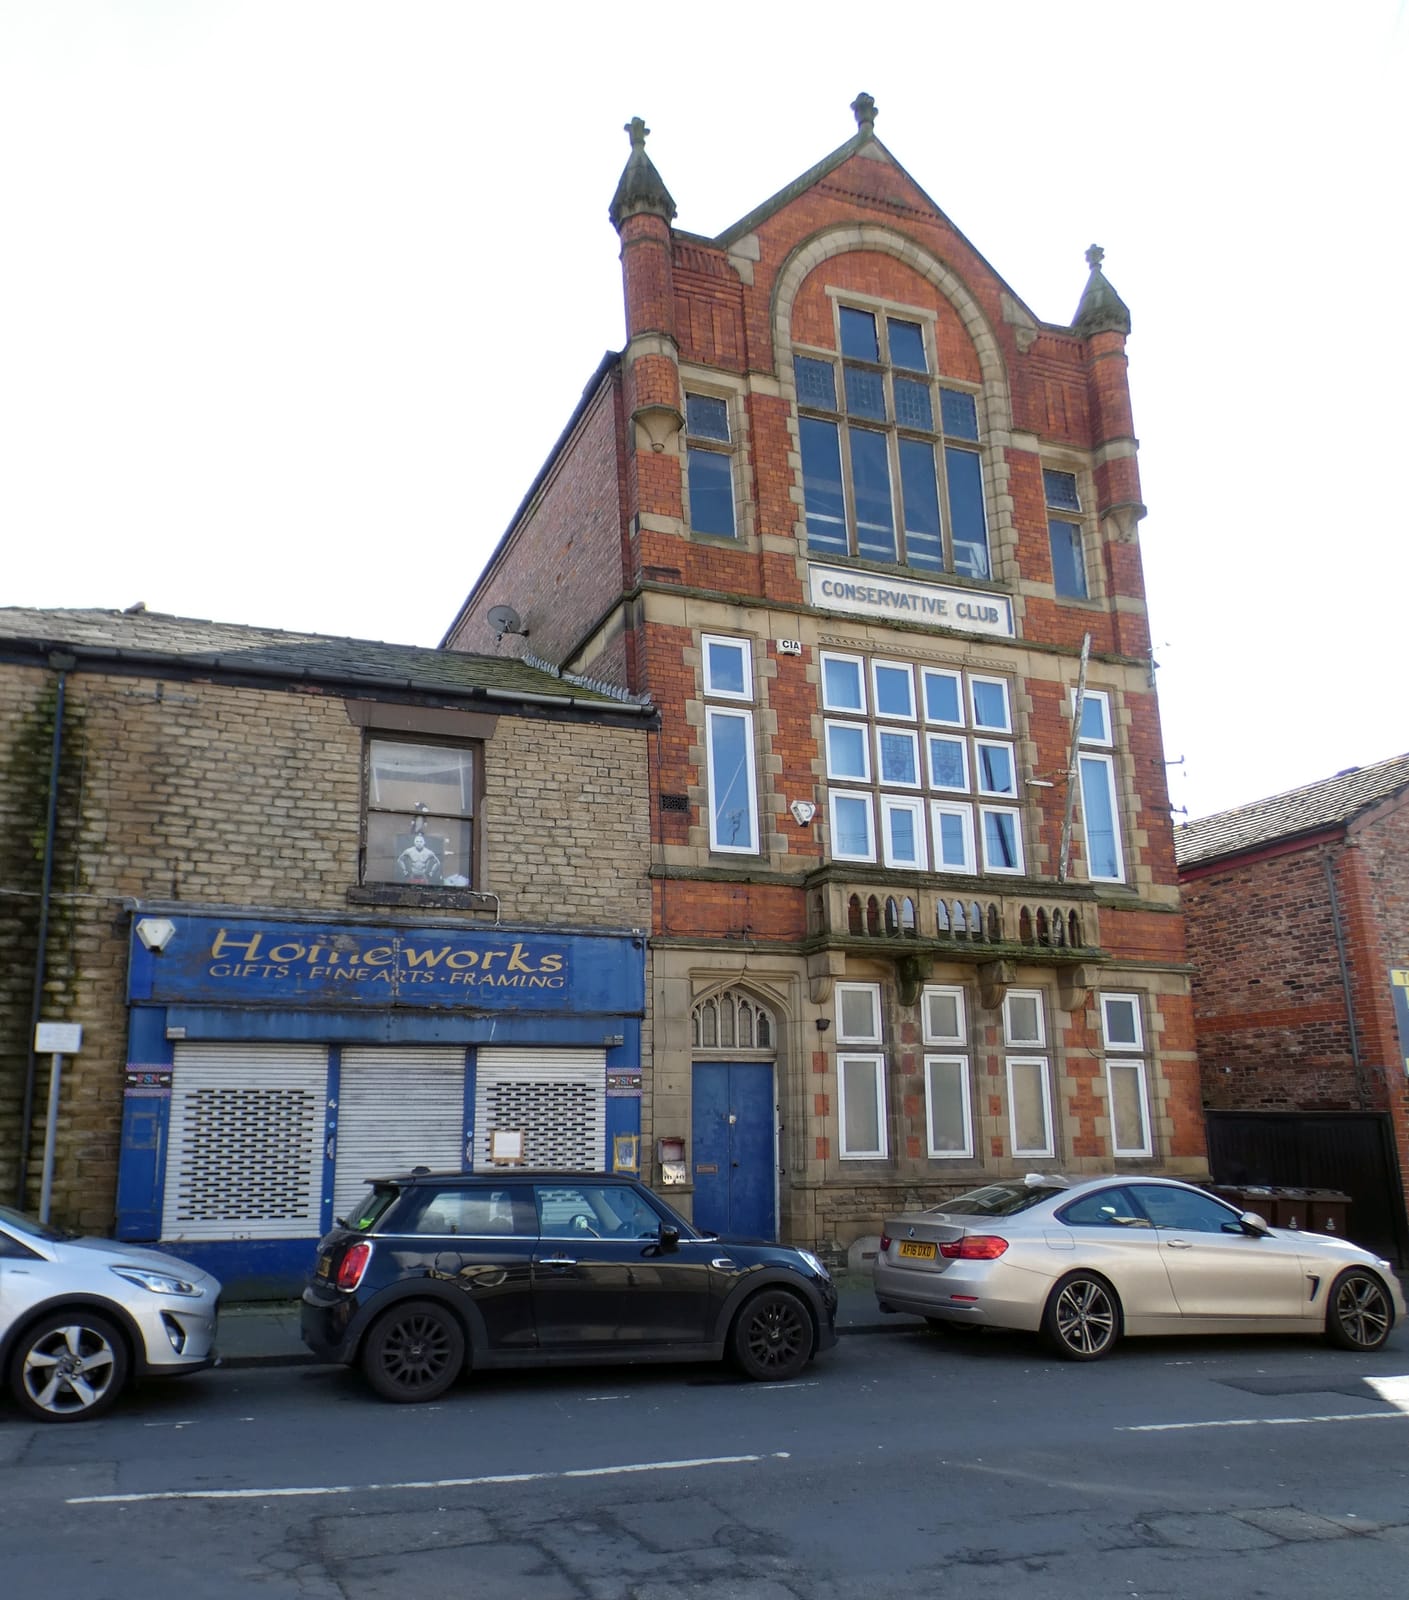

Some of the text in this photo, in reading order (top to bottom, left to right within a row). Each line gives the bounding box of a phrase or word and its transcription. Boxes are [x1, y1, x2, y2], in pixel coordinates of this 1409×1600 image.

[821, 579, 999, 624] CONSERVATIVE CLUB
[782, 640, 800, 650] CIA
[211, 928, 563, 973] Homeworks
[209, 964, 564, 989] GIFTS FINE ARTS FRAMING
